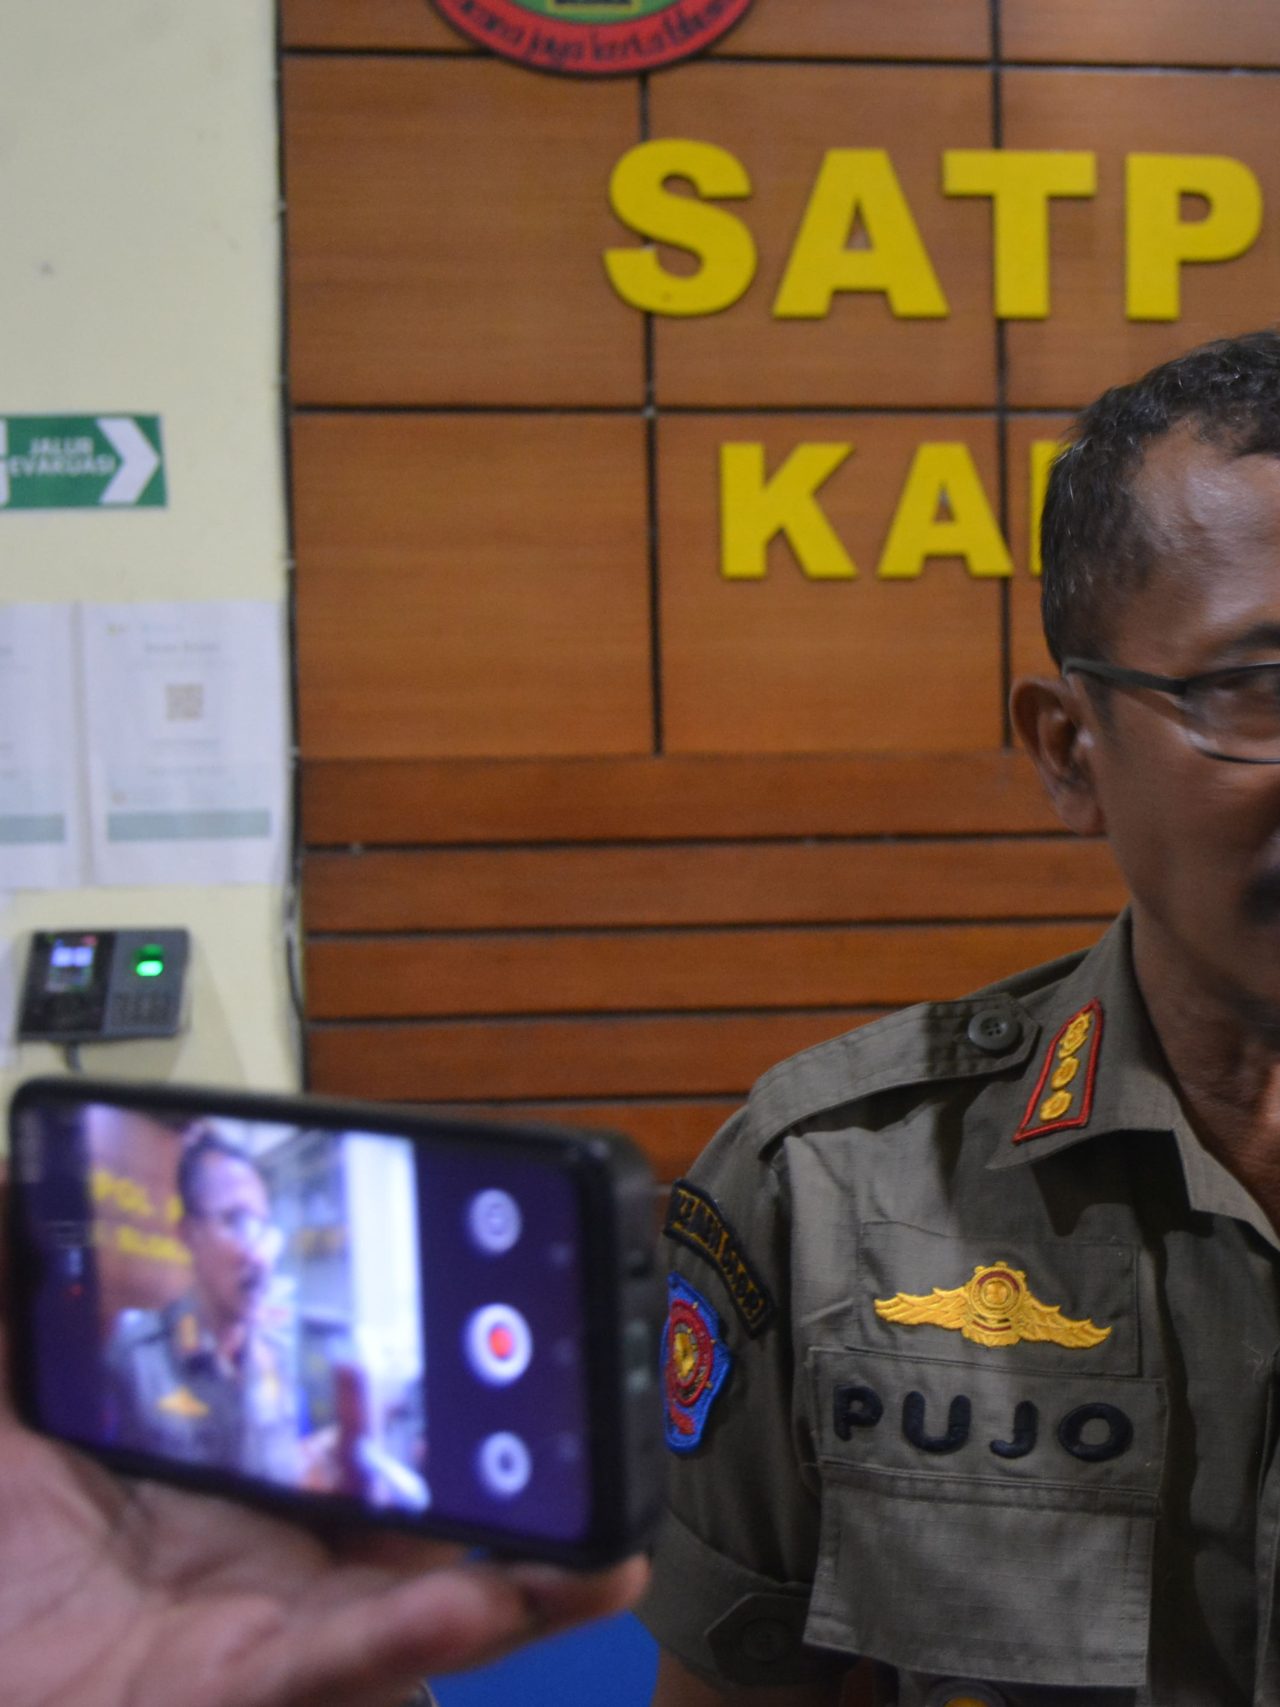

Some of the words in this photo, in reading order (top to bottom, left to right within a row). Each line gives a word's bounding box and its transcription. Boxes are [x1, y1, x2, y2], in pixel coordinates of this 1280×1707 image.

[30, 436, 94, 456] JALUR
[718, 441, 1062, 579] KA
[833, 1385, 1134, 1462] PUJO
